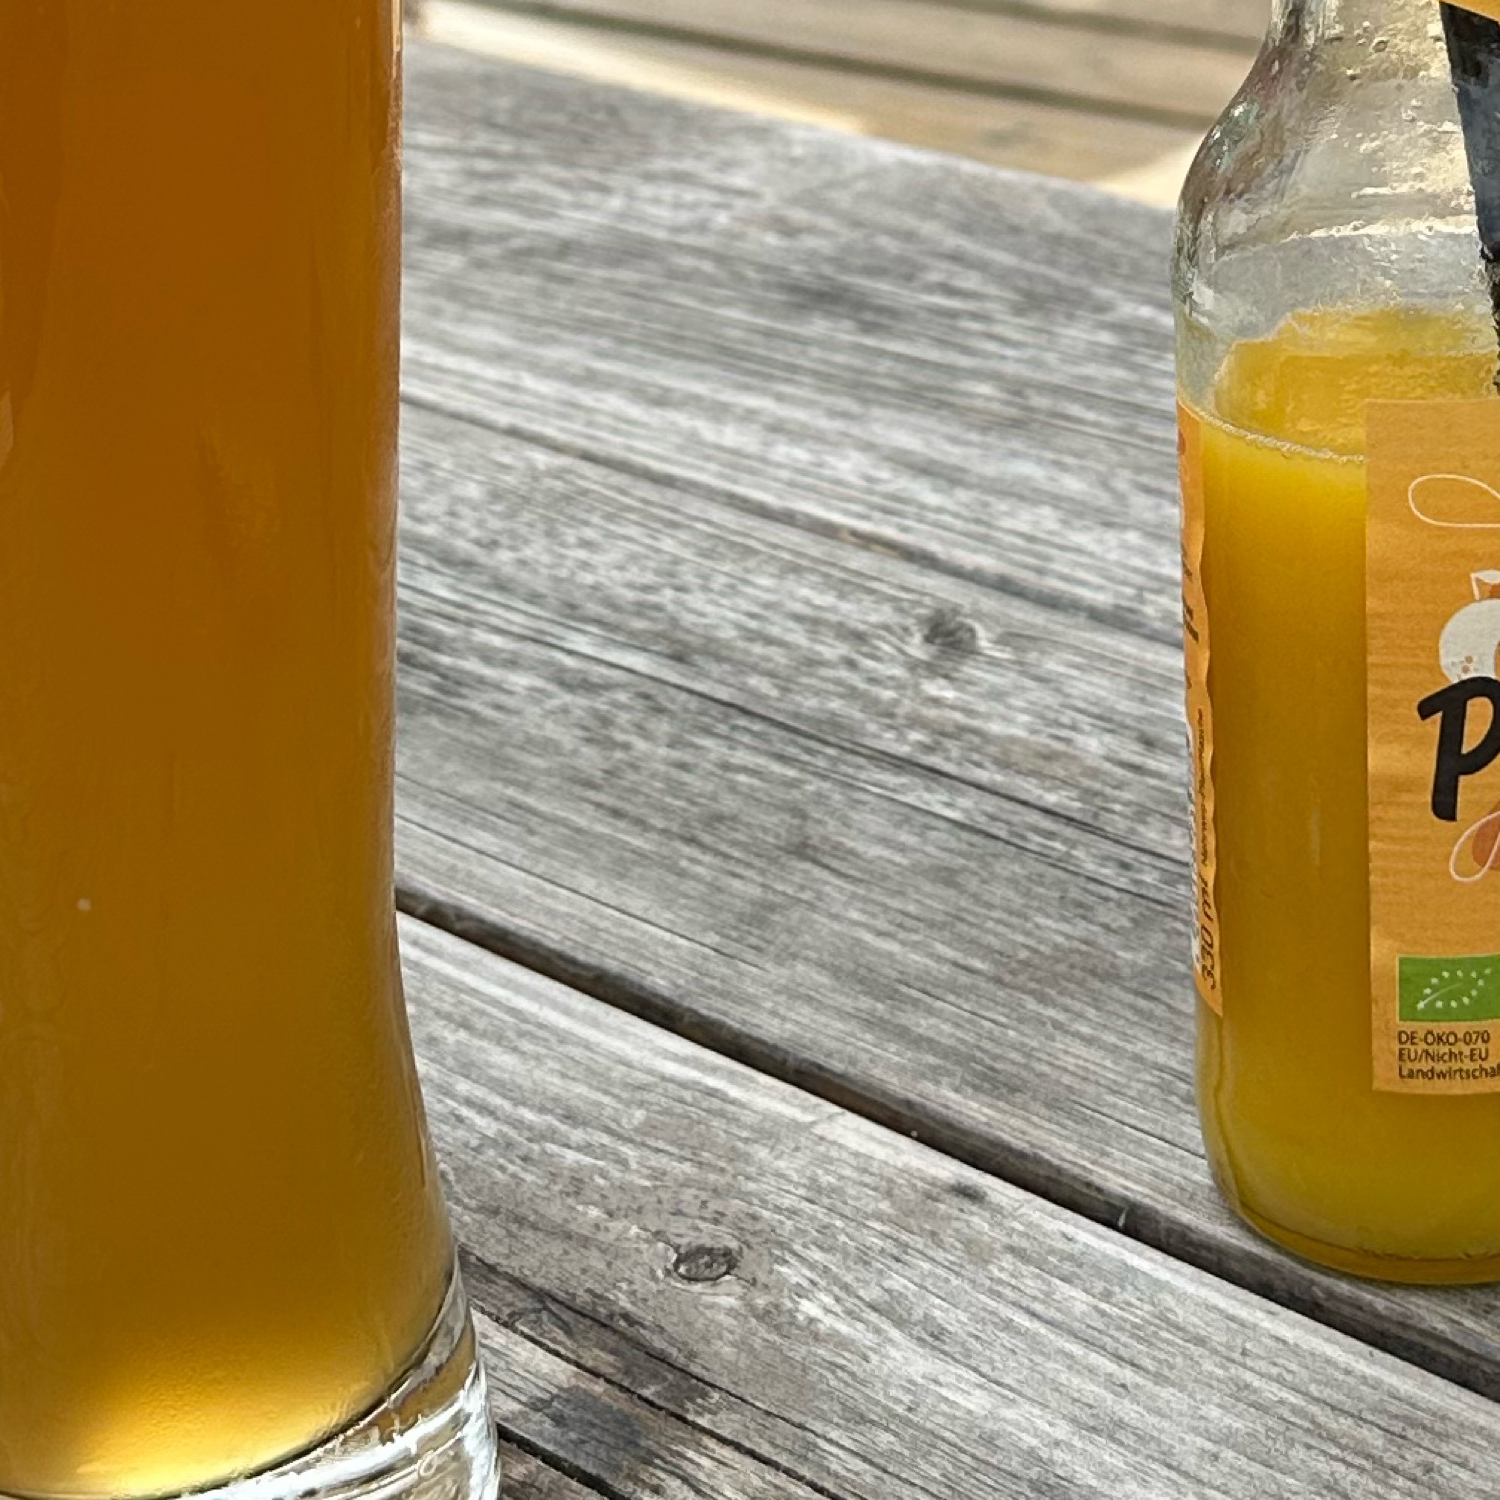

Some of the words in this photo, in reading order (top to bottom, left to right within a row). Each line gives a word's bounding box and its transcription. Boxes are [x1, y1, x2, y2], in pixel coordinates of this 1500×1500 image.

[1200, 926, 1216, 991] 330
[1397, 1029, 1491, 1046] DE-ÖKO-070
[1398, 1047, 1490, 1063] EU/Nicht-EU
